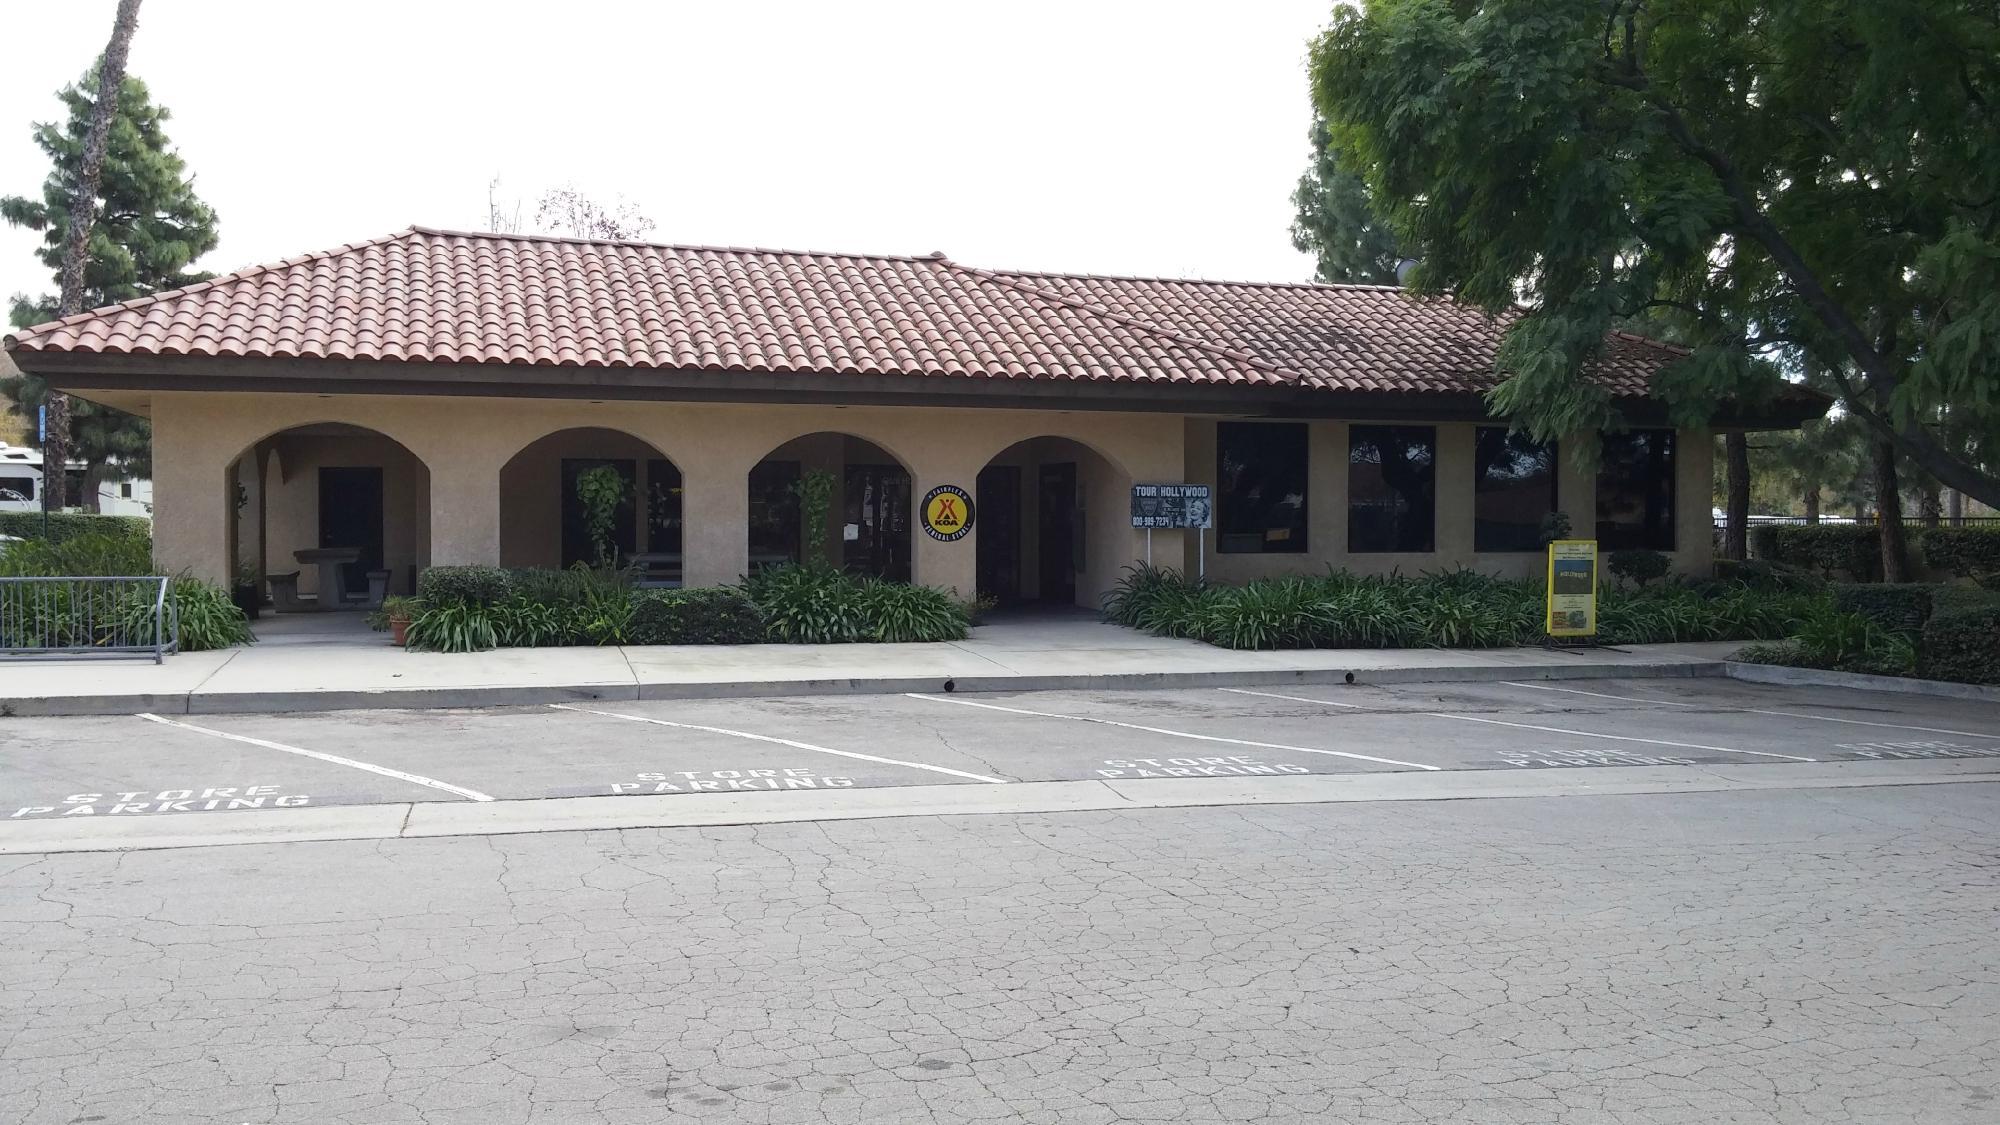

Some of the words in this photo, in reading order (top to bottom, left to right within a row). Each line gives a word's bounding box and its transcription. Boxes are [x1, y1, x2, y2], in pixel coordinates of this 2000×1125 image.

[1135, 486, 1157, 497] TOUR
[1160, 486, 1208, 497] HOLLYWOOD
[925, 525, 949, 541] GENERAL
[951, 526, 969, 540] STORE
[1496, 749, 1642, 758] STORE
[1104, 755, 1264, 768] STORE
[1501, 756, 1696, 767] PARKING
[636, 768, 816, 782] STORE
[1096, 764, 1310, 778] PARKING
[609, 776, 856, 793] PARKING
[61, 785, 281, 804] STORE
[10, 794, 310, 818] PARKING
